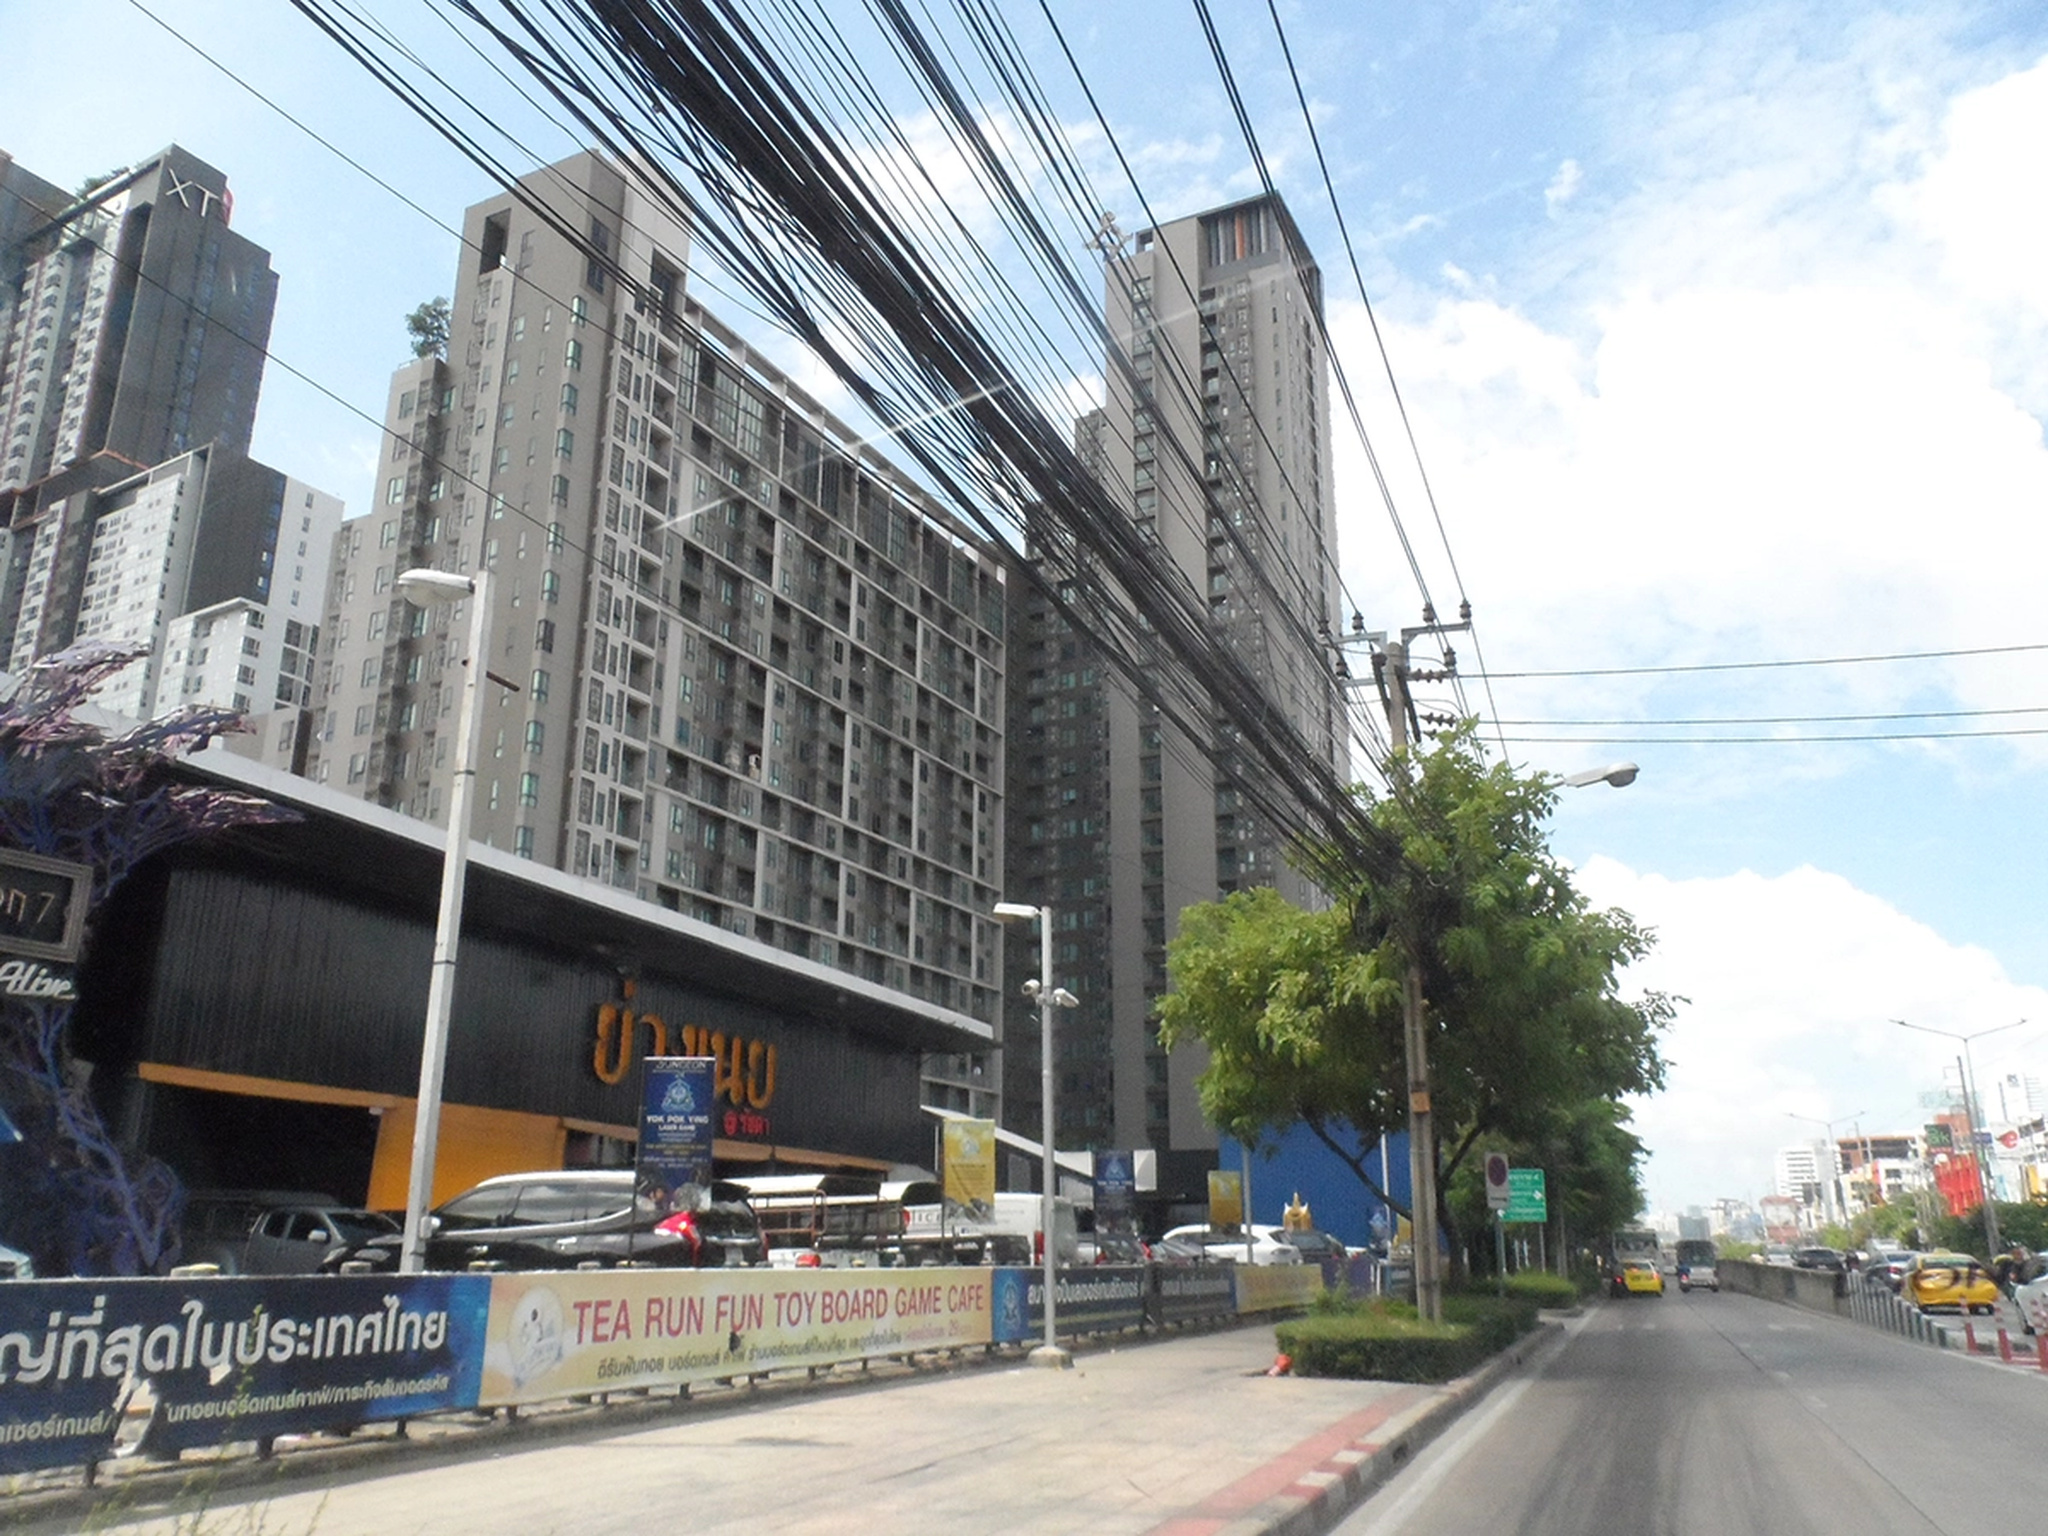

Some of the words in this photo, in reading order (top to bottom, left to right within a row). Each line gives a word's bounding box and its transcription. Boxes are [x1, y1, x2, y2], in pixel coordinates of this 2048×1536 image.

[165, 167, 220, 217] XT
[573, 1297, 632, 1344] TEA
[645, 1296, 704, 1338] RUN
[714, 1293, 764, 1333] FUN
[774, 1290, 817, 1327] TOY
[821, 1287, 889, 1324] BOARD
[894, 1285, 943, 1318] GAME
[947, 1284, 985, 1313] CAFE
